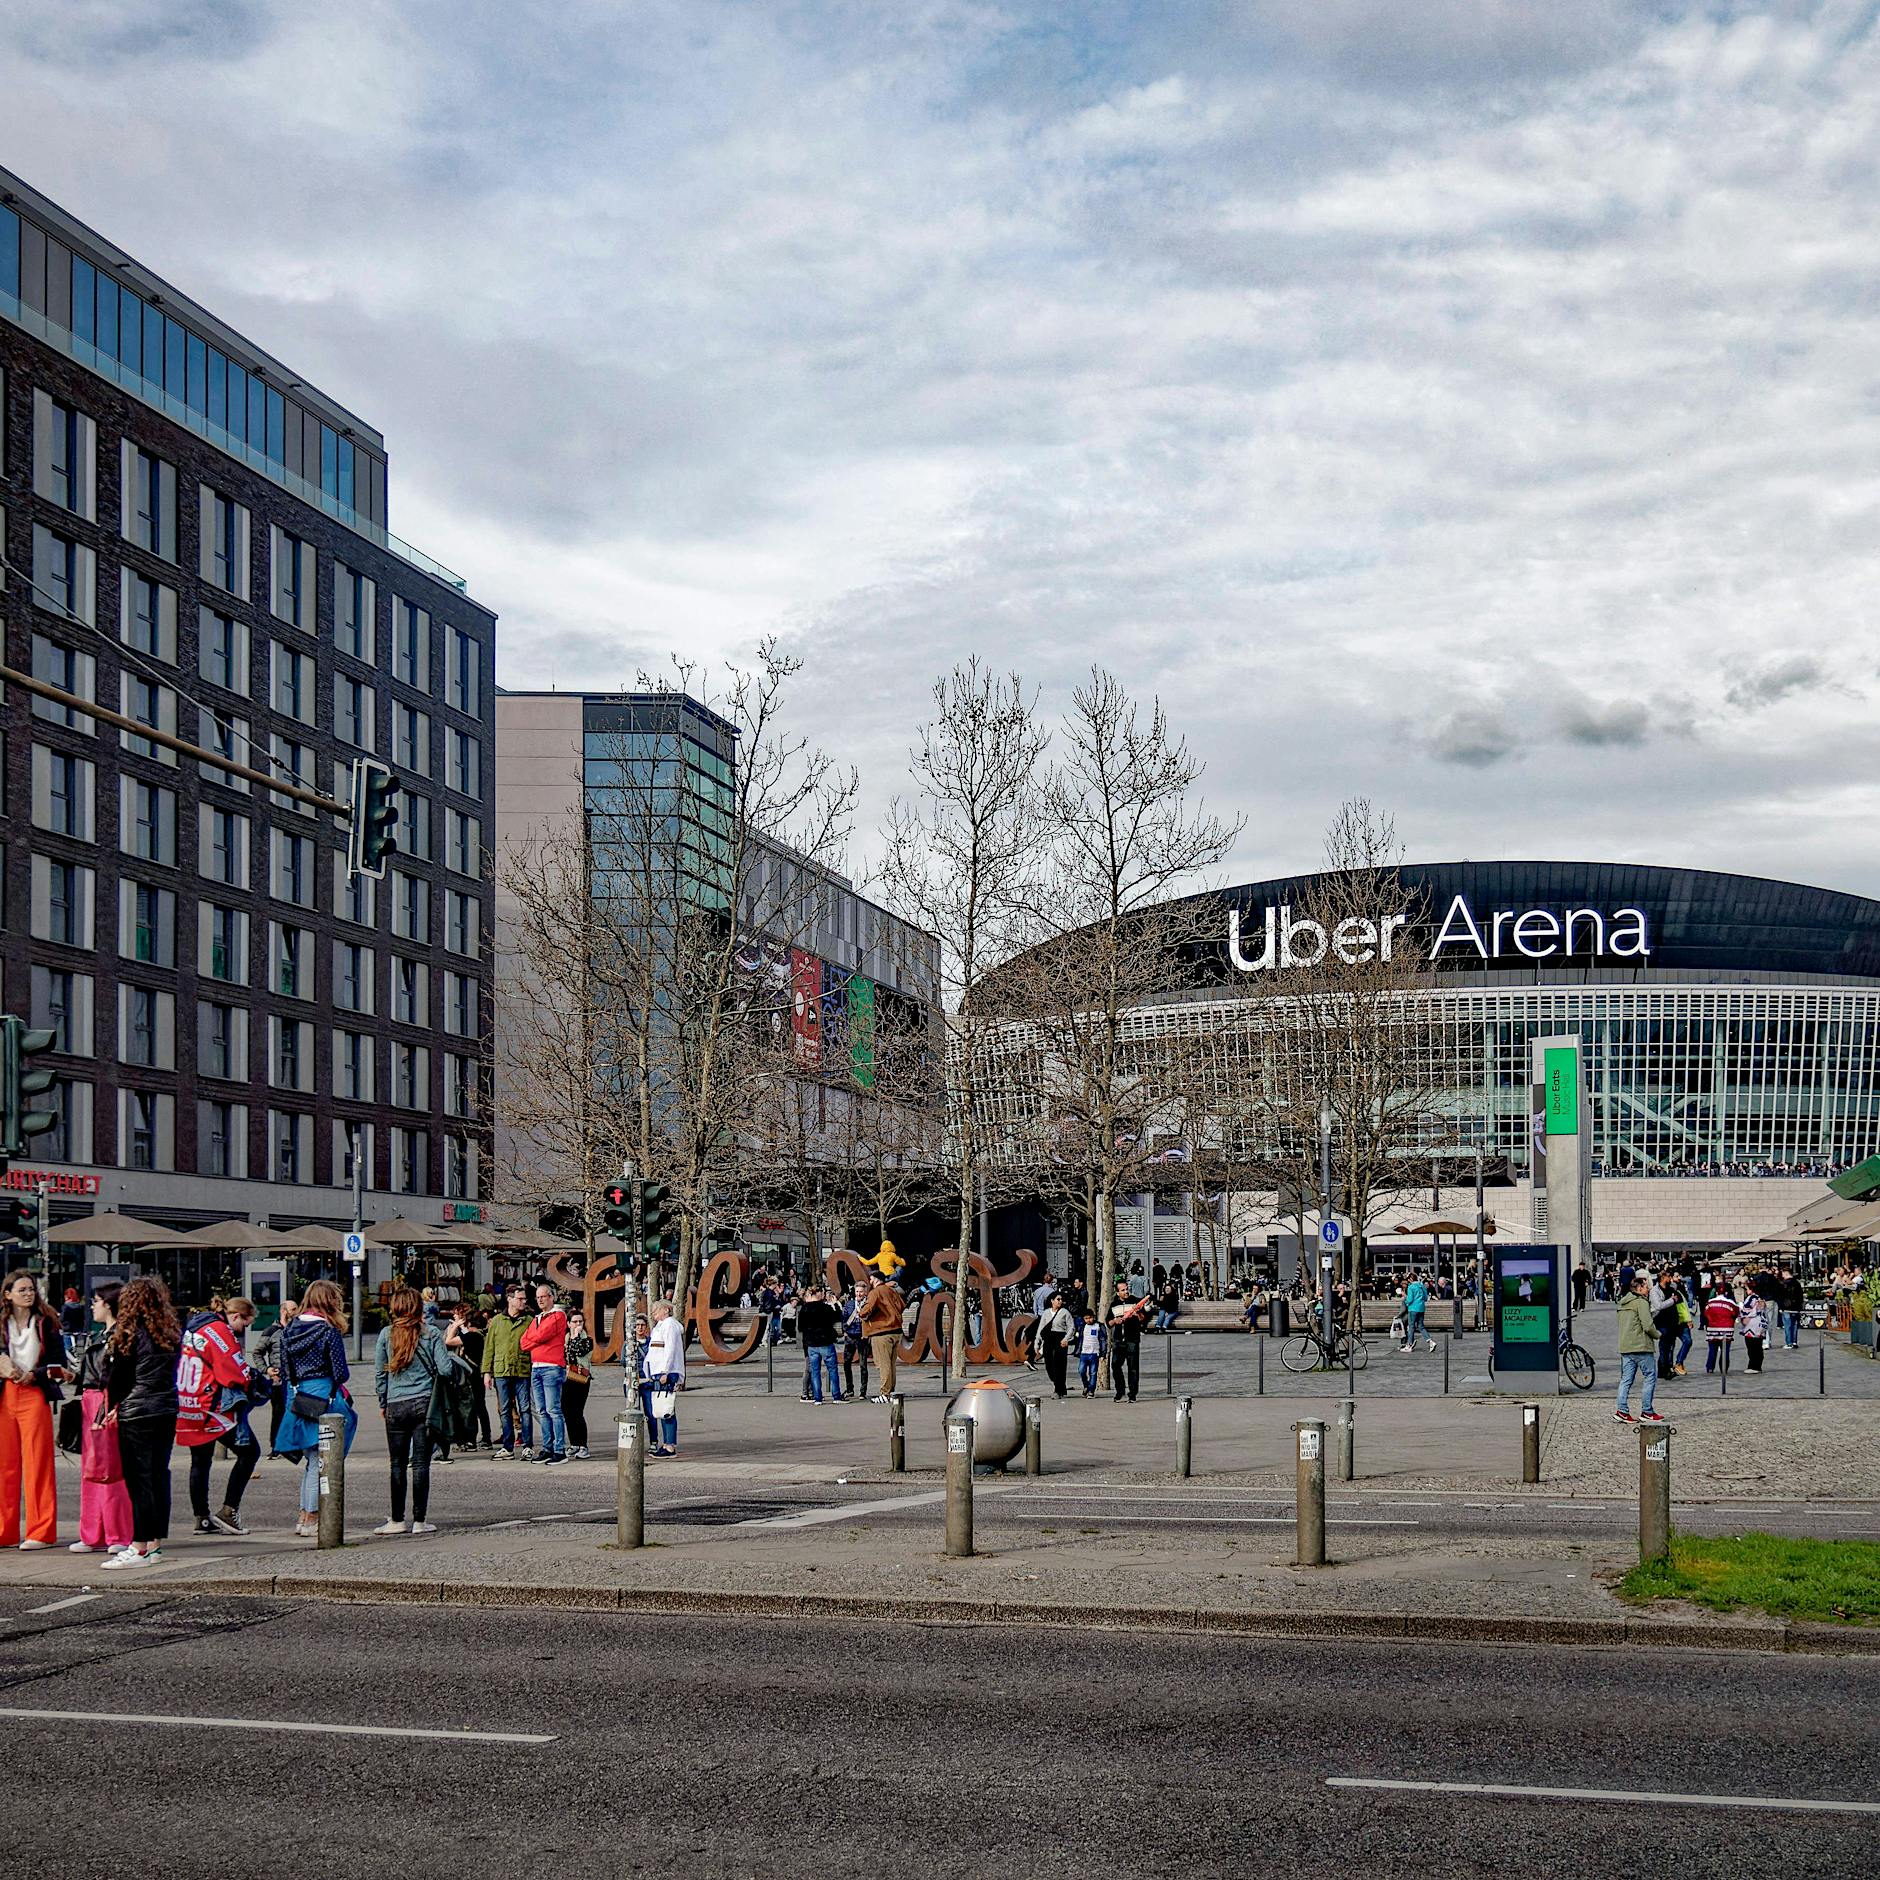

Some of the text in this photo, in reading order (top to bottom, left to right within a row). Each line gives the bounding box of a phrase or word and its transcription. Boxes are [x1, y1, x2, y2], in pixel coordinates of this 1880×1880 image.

[1228, 894, 1651, 972] Uber Arena
[1551, 1069, 1561, 1115] Uber Eats
[0, 1168, 103, 1196] IRTSCHAFT
